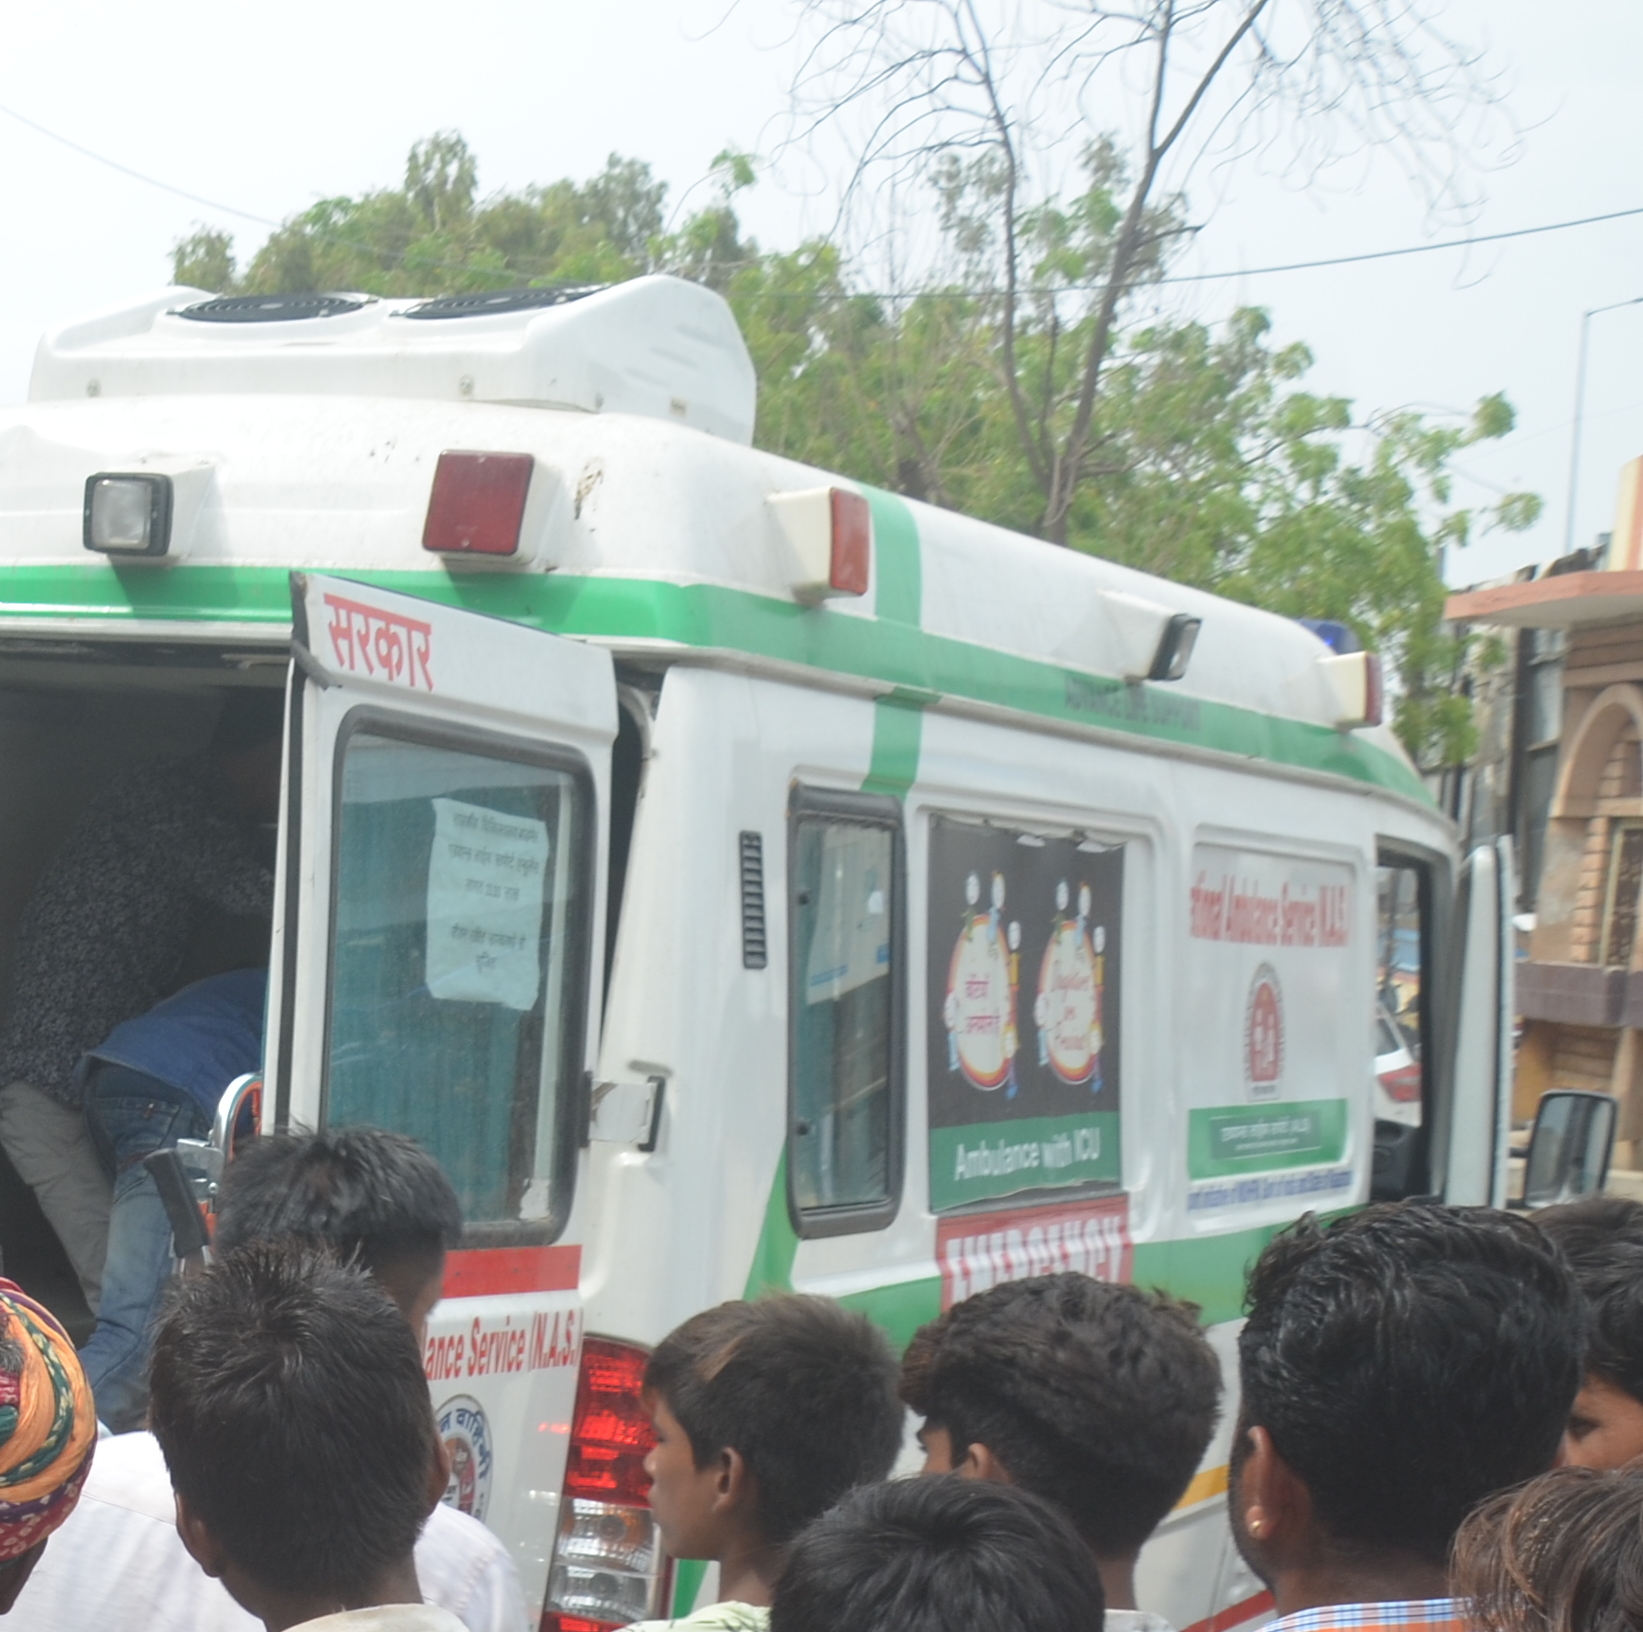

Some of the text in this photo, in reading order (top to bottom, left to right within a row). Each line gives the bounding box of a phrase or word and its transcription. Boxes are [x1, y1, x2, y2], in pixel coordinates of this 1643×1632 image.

[323, 593, 434, 691] सरकार
[953, 1126, 1101, 1182] Ambulance with ICU
[467, 1314, 526, 1378] Service
